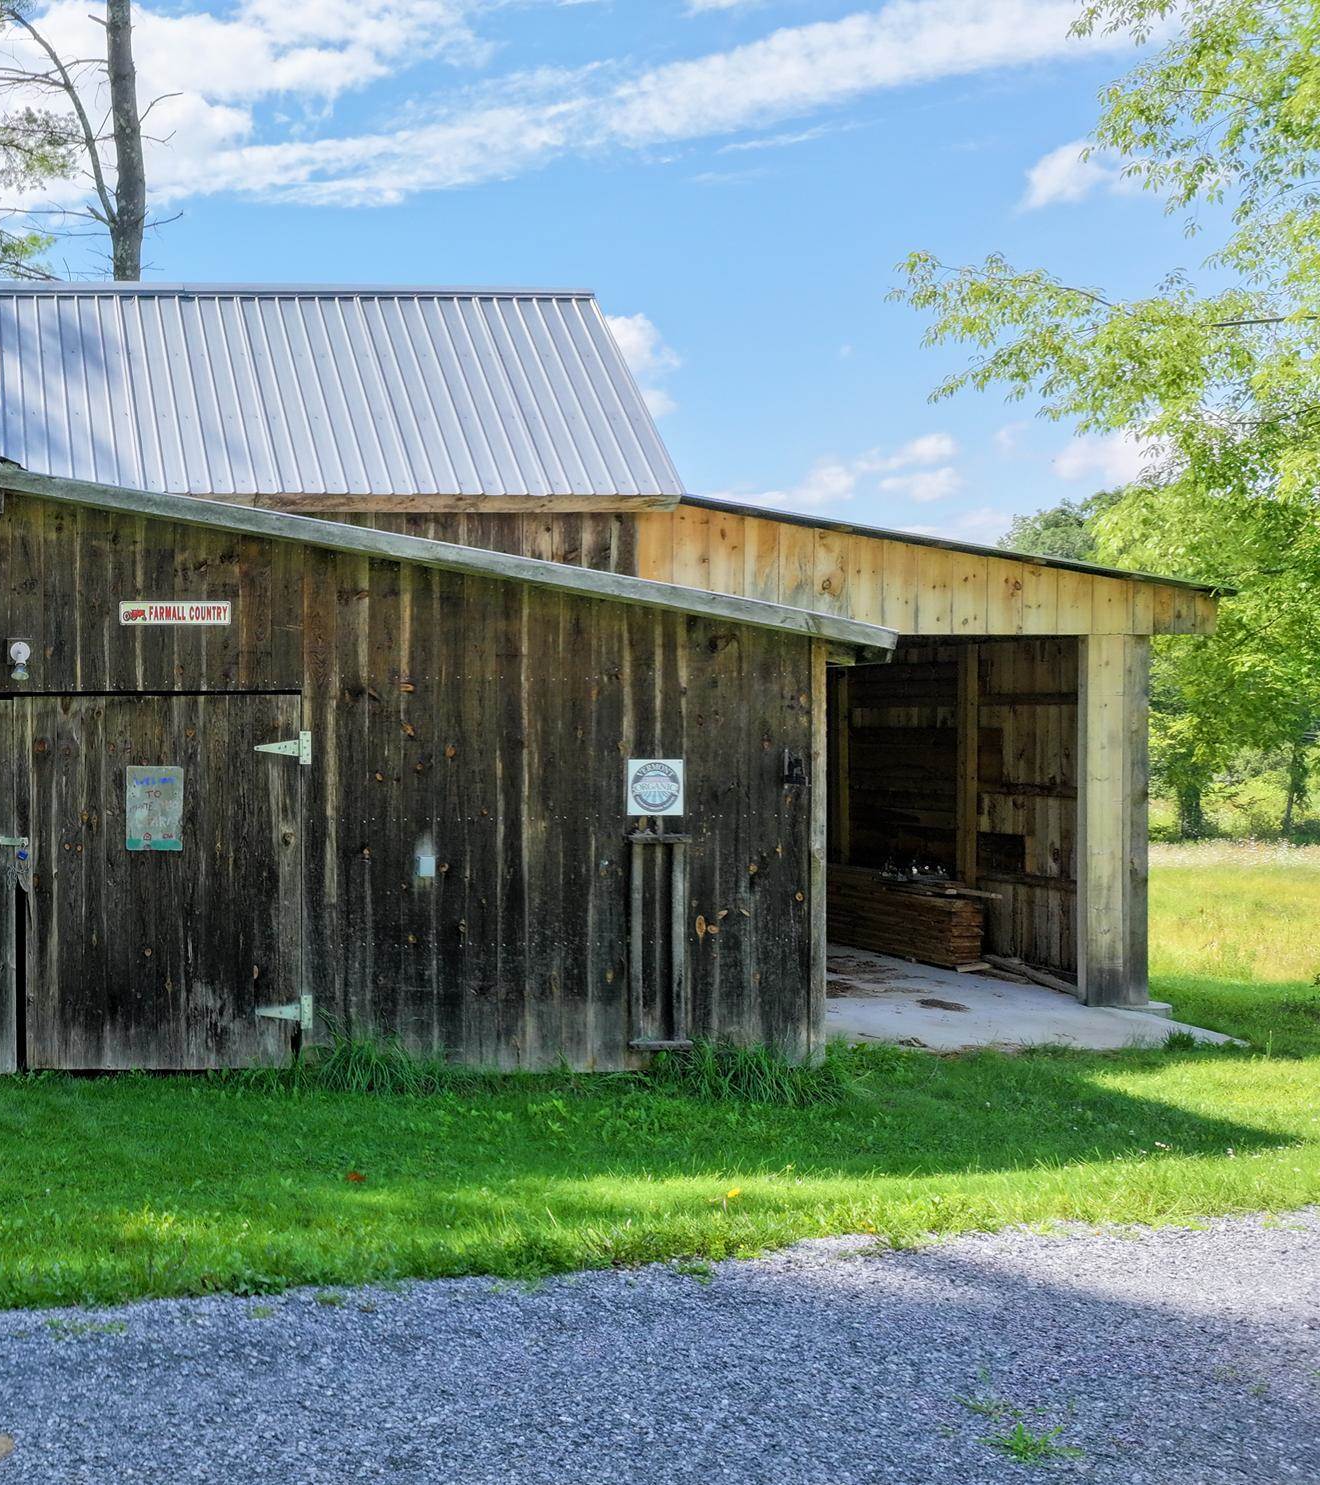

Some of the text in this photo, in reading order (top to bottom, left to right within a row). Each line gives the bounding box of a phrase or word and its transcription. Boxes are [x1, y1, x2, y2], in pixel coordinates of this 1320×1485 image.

[149, 606, 228, 620] FARMALL COUNTRY
[145, 790, 161, 798] TO
